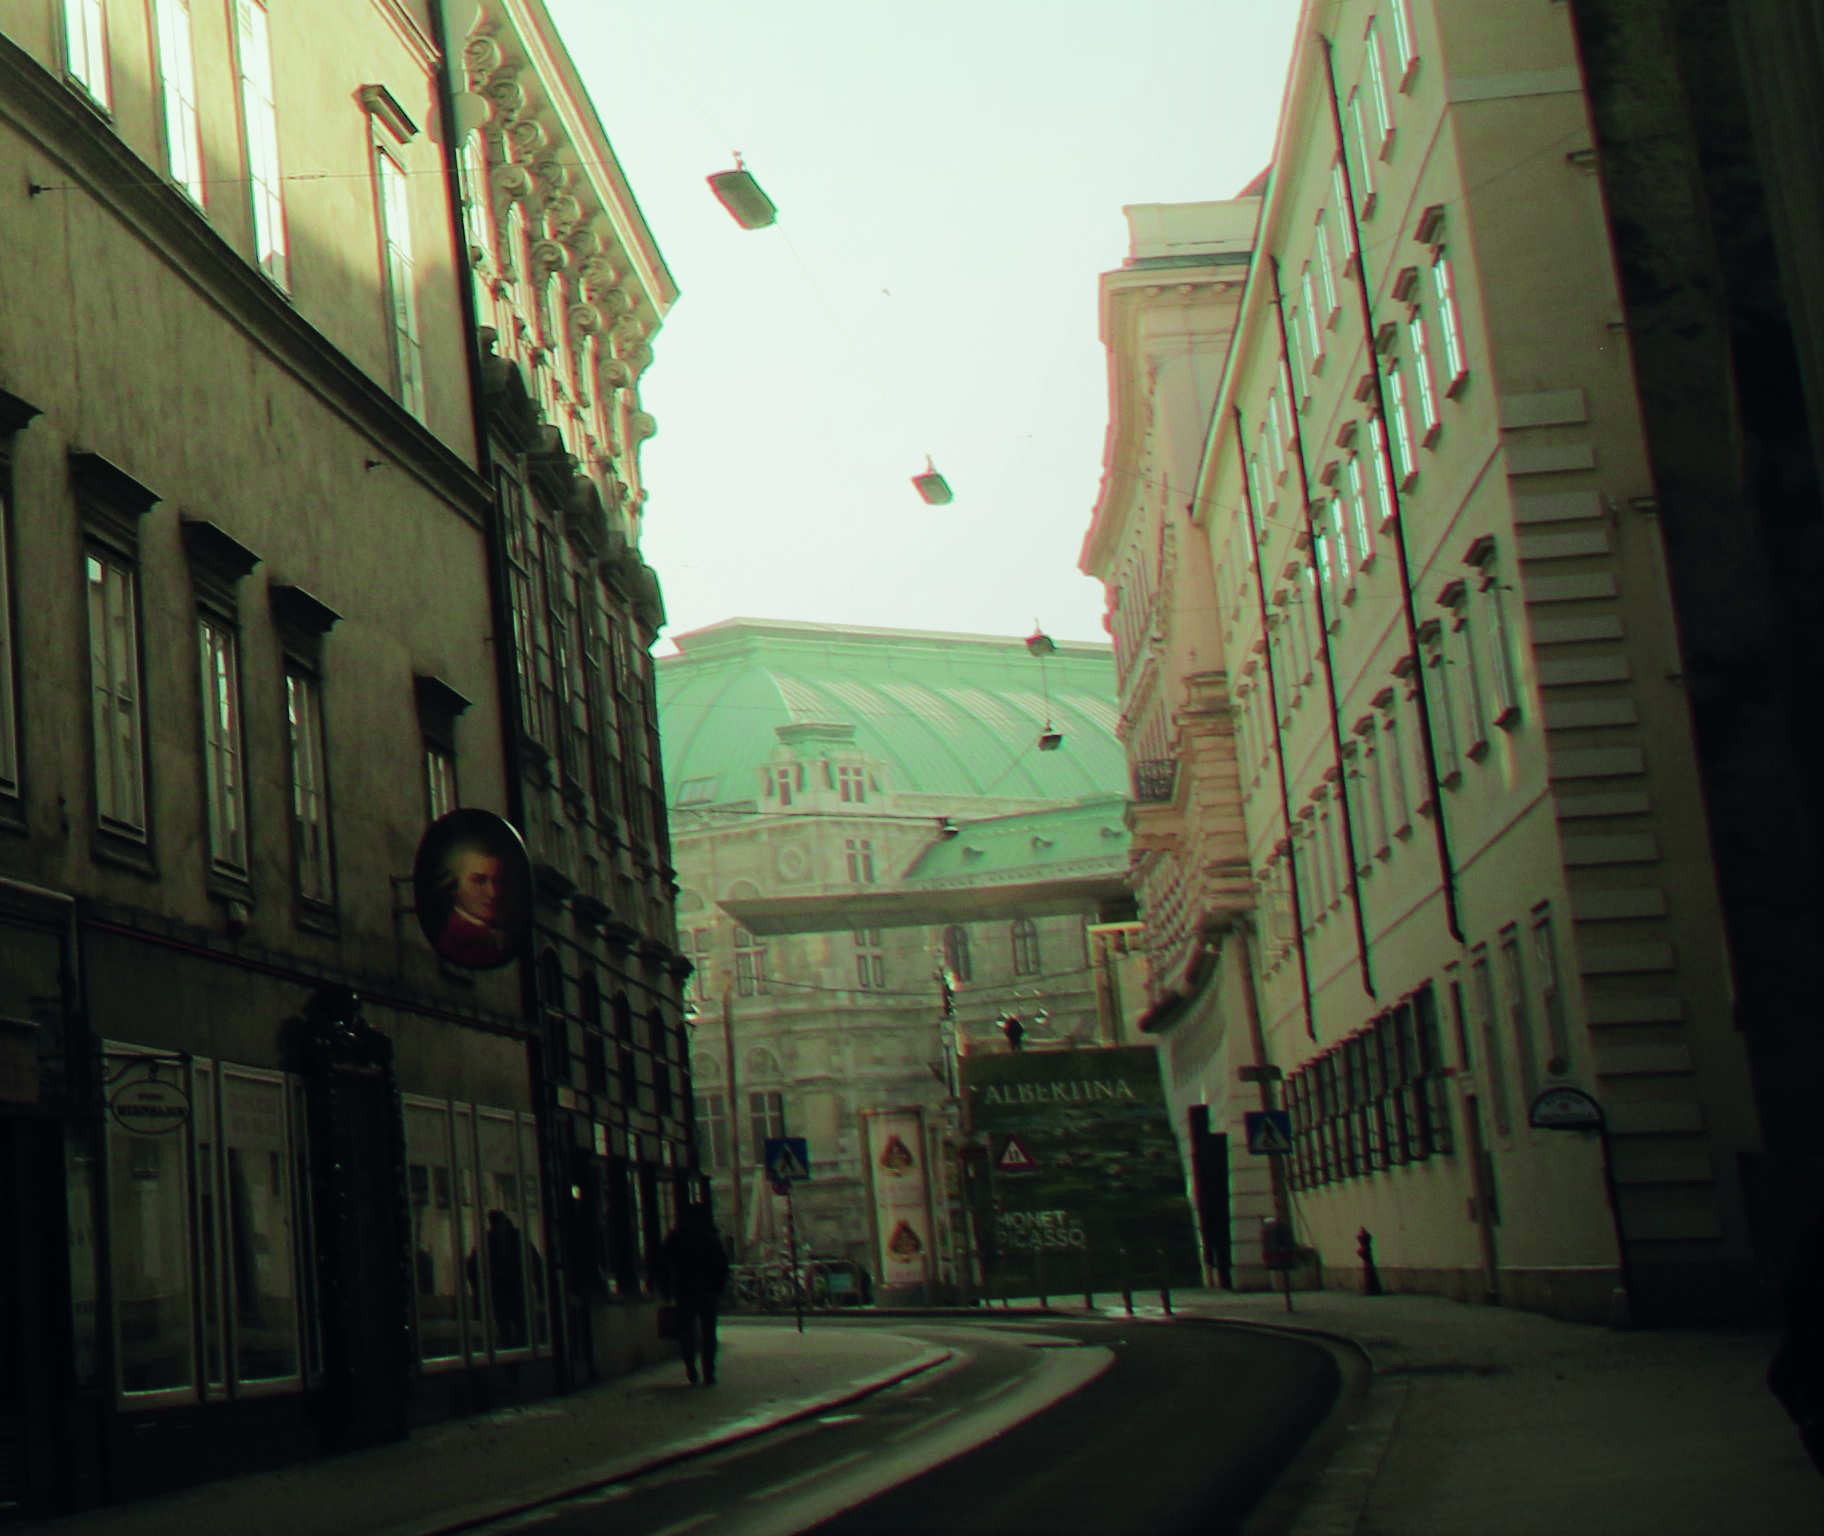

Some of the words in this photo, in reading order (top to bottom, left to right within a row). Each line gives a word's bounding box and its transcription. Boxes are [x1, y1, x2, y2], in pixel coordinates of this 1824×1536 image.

[984, 1077, 1135, 1105] ALBERTINA
[995, 1209, 1068, 1230] MONET
[996, 1227, 1086, 1249] PICASSO
